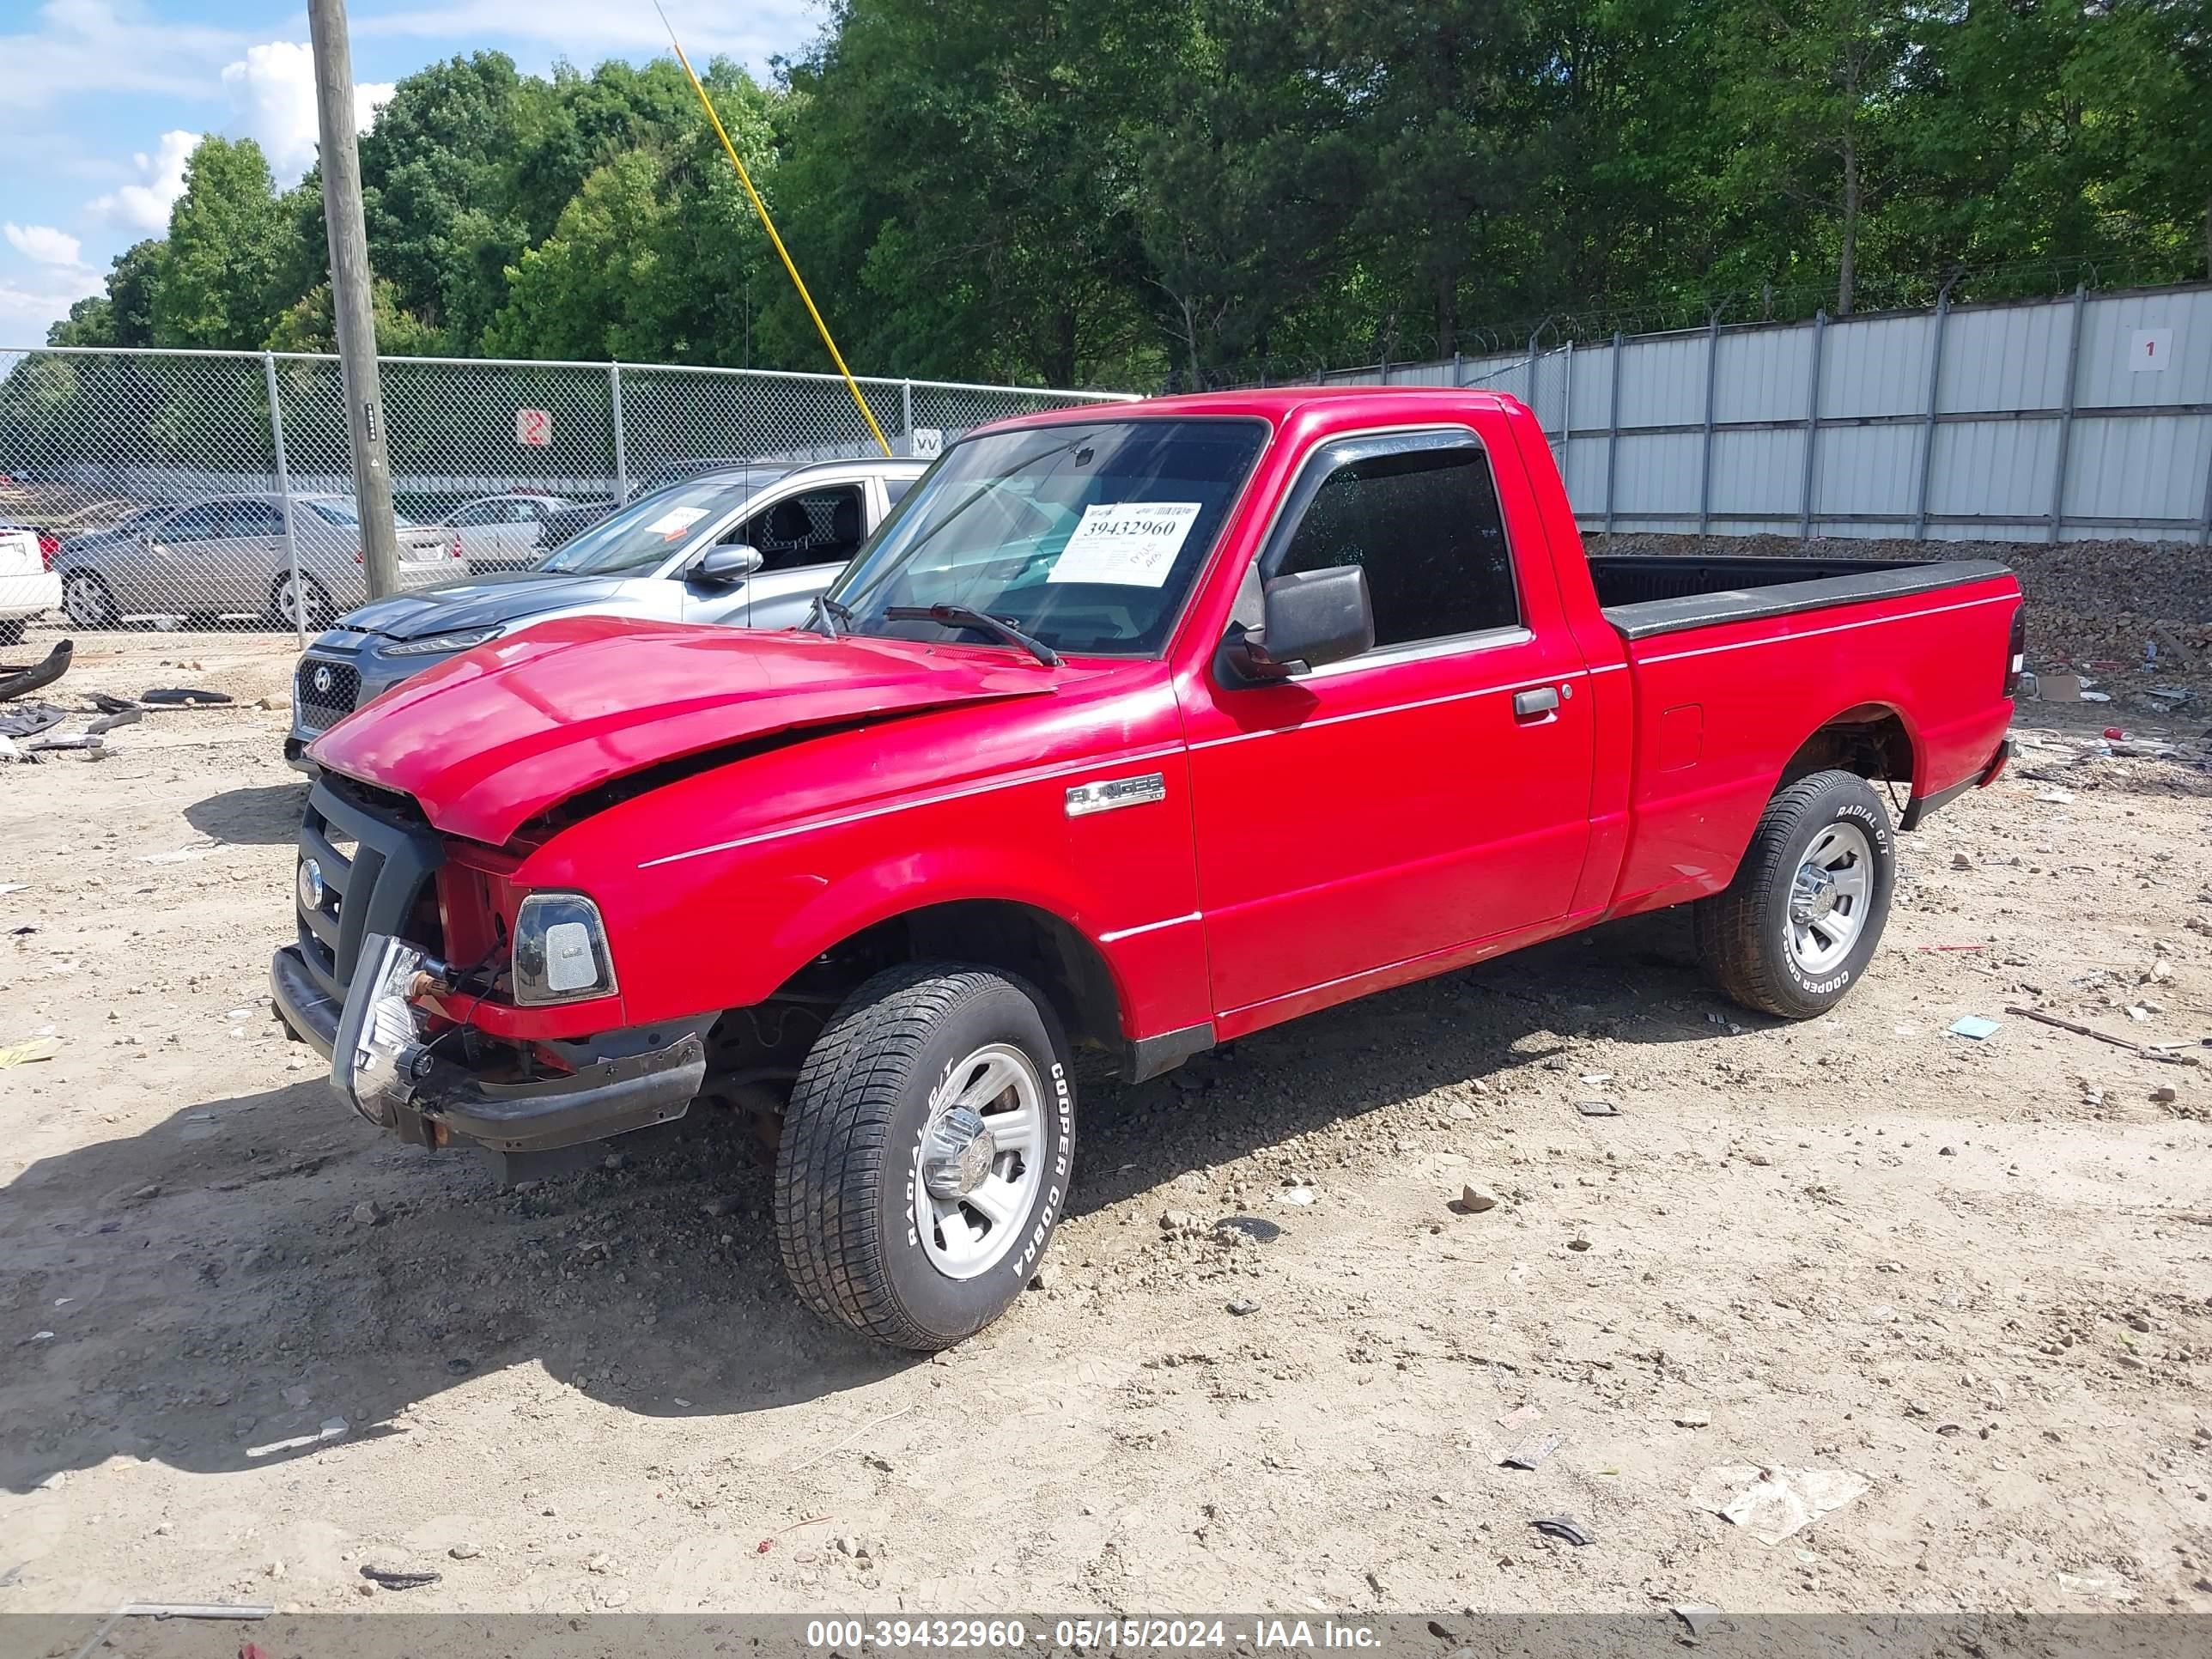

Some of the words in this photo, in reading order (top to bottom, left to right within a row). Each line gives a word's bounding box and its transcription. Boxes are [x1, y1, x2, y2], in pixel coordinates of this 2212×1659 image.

[2146, 341, 2154, 356] 1
[526, 411, 544, 442] 2
[1084, 520, 1176, 536] 39432960
[1836, 805, 1878, 829] RADIAL
[1875, 829, 1890, 856] G/T
[1802, 970, 1850, 994] COOPER
[1051, 1062, 1069, 1176] COOPER
[1012, 1185, 1060, 1279] COBRA
